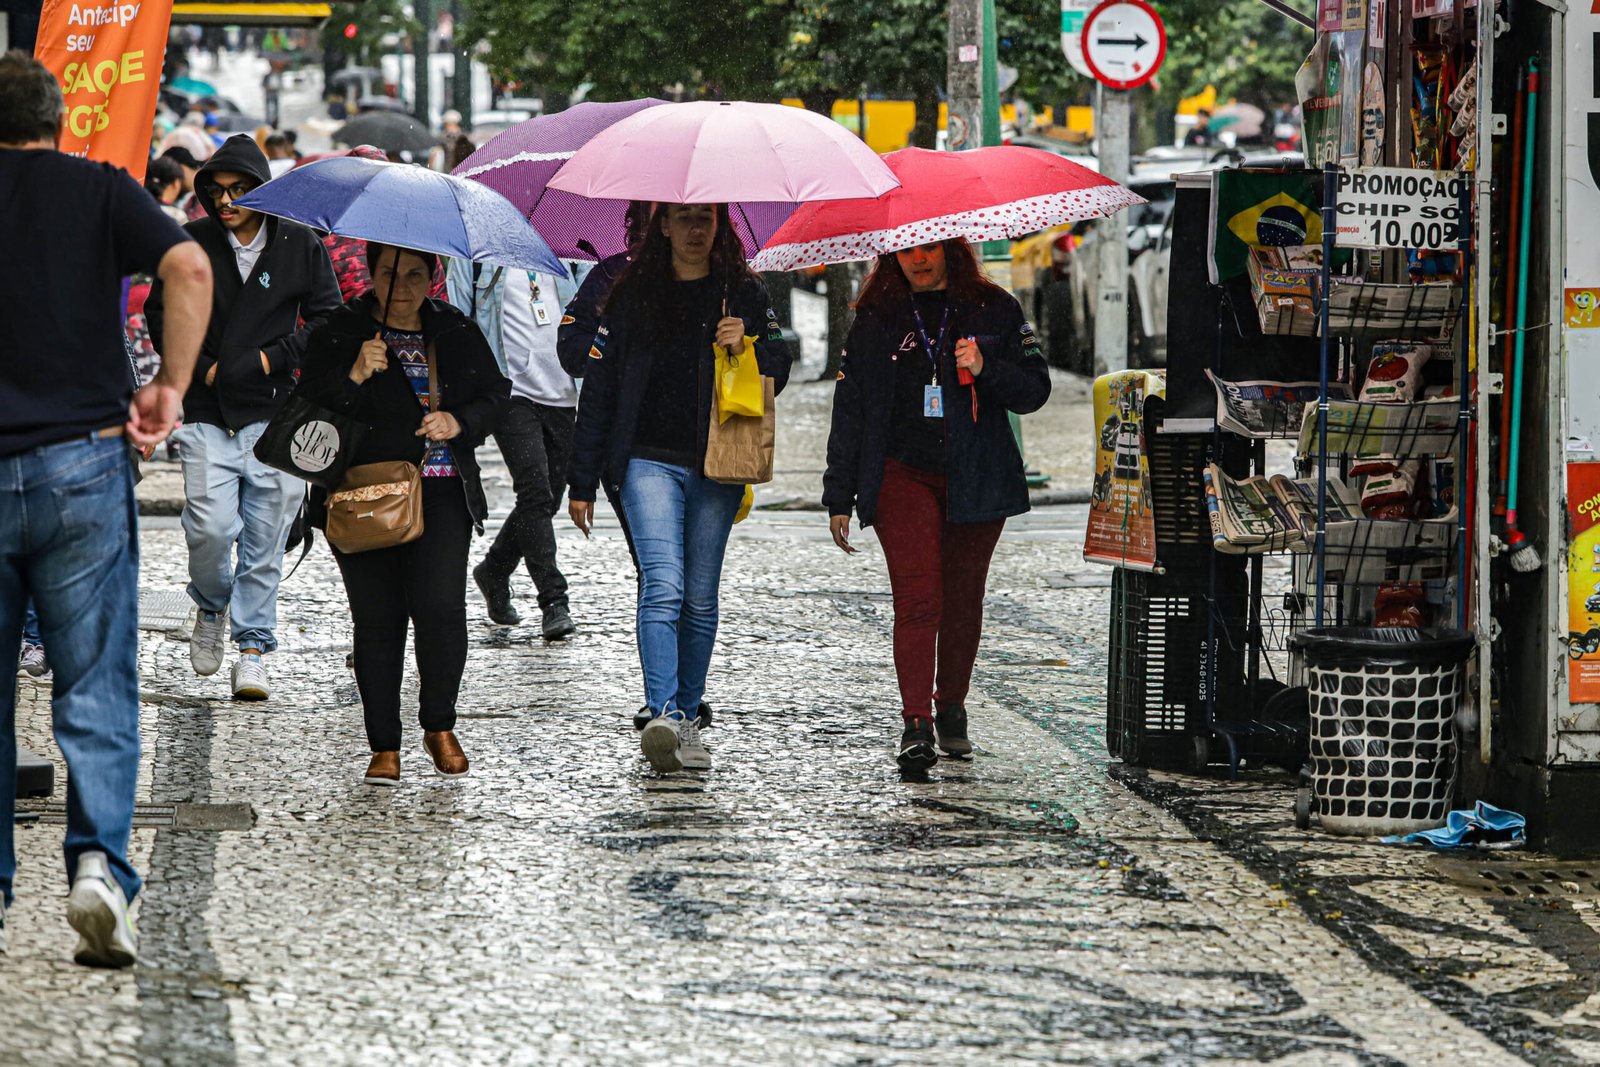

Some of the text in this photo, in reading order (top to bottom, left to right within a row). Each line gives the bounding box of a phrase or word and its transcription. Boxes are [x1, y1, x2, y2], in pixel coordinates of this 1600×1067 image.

[66, 34, 96, 52] seu
[1336, 202, 1459, 220] CHIP SÓ
[292, 434, 337, 464] SHOP
